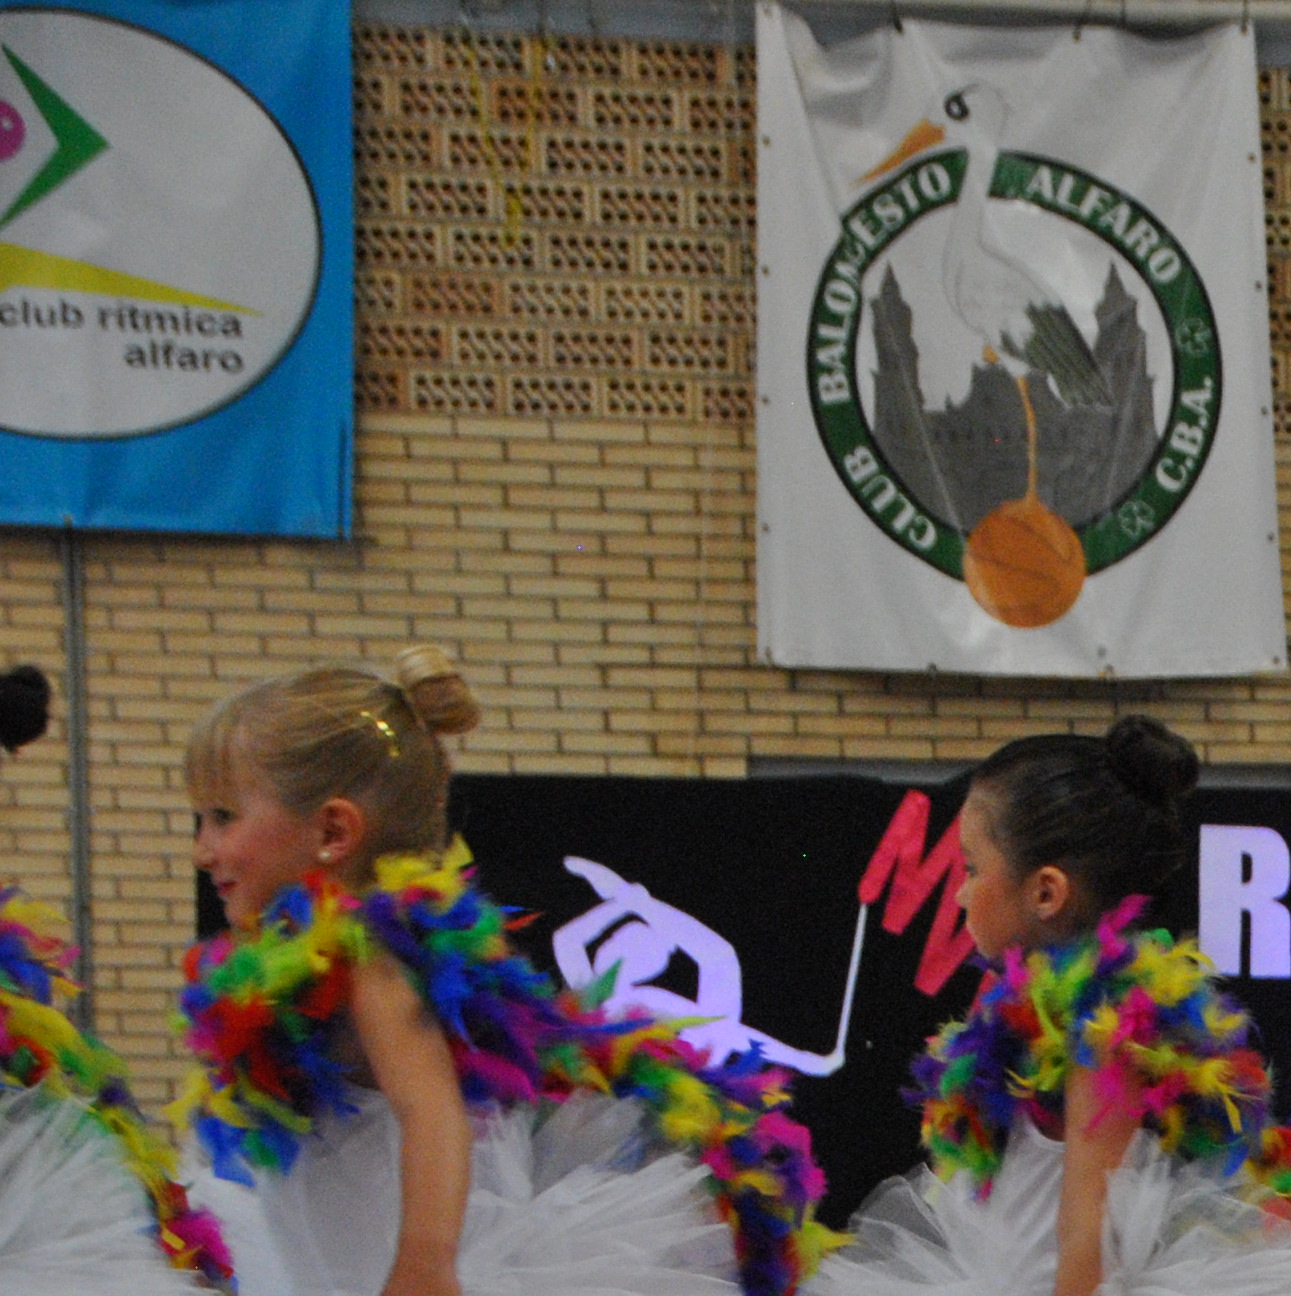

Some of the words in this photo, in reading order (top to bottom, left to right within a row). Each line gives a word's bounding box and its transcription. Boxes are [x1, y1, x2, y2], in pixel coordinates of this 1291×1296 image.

[1025, 164, 1182, 284] ALFARO
[0, 297, 84, 329] club
[124, 339, 244, 374] alfaro
[1155, 376, 1214, 491] C.B.A.
[843, 445, 938, 551] CLUB
